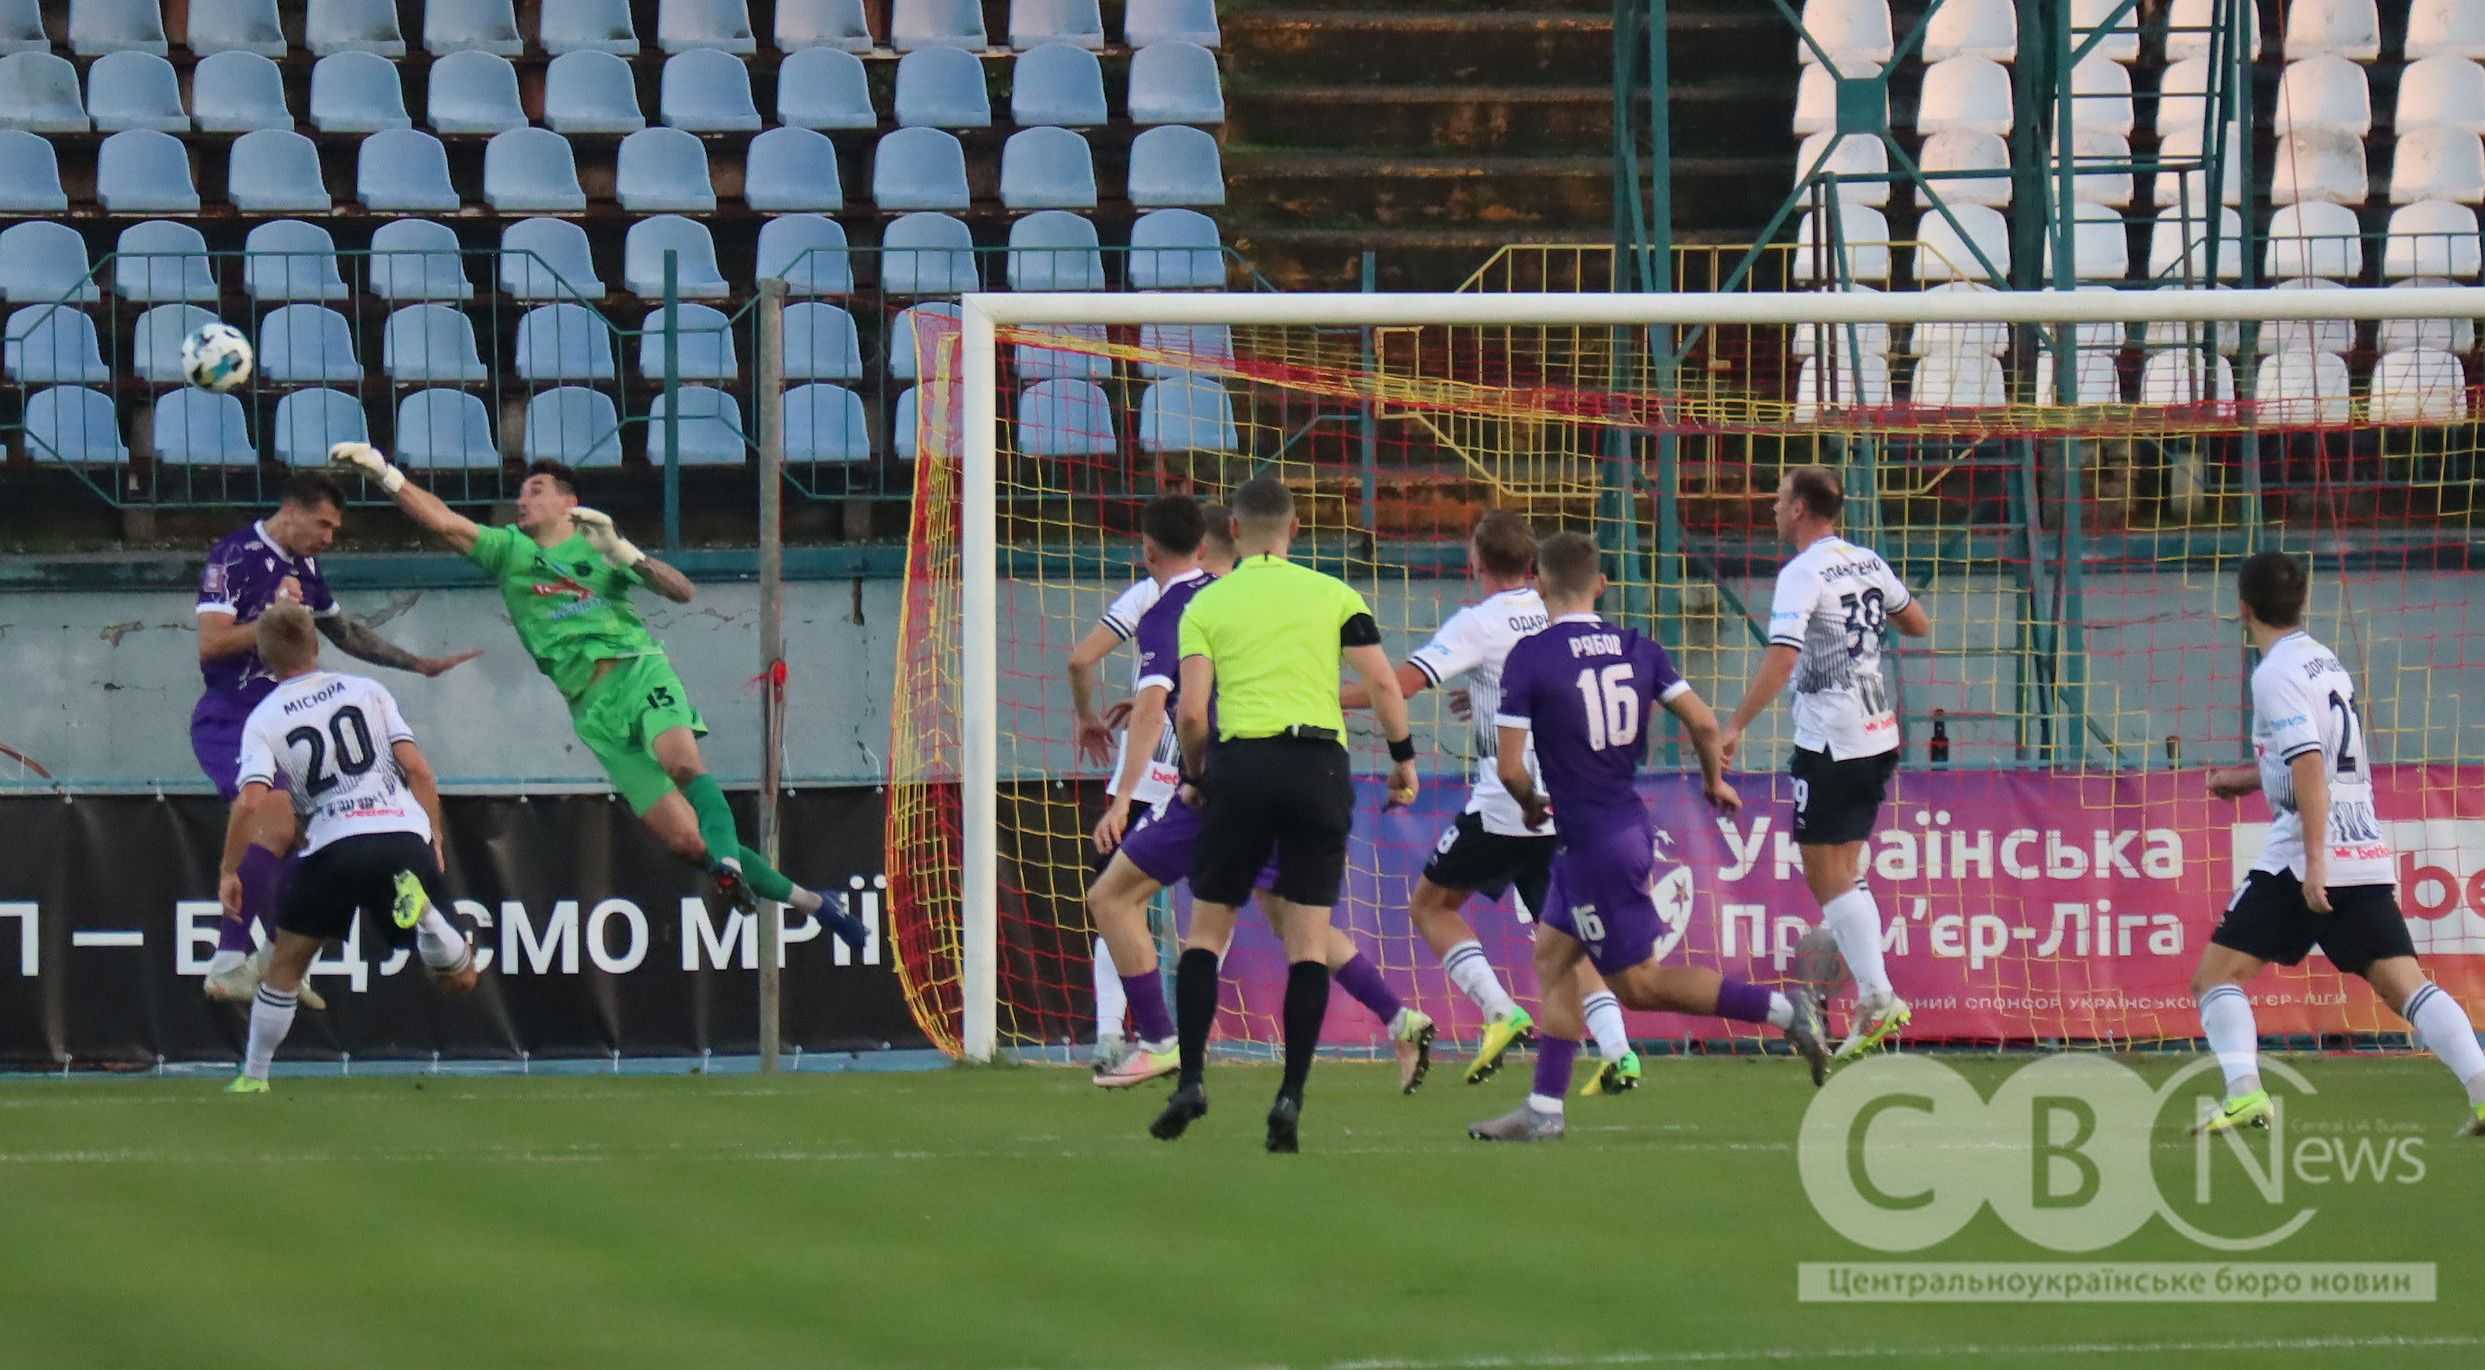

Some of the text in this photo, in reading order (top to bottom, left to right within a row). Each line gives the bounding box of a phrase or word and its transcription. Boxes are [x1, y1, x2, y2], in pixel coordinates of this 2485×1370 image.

[1568, 633, 1623, 658] РЯБОВ
[283, 681, 347, 716] МІСЮРА
[646, 686, 676, 710] 13
[1575, 663, 1640, 752] 16
[2329, 689, 2362, 773] 2
[286, 704, 376, 798] 20
[1791, 777, 1809, 813] 9
[1717, 810, 2184, 882] Укаїнська
[1571, 904, 1606, 943] 16
